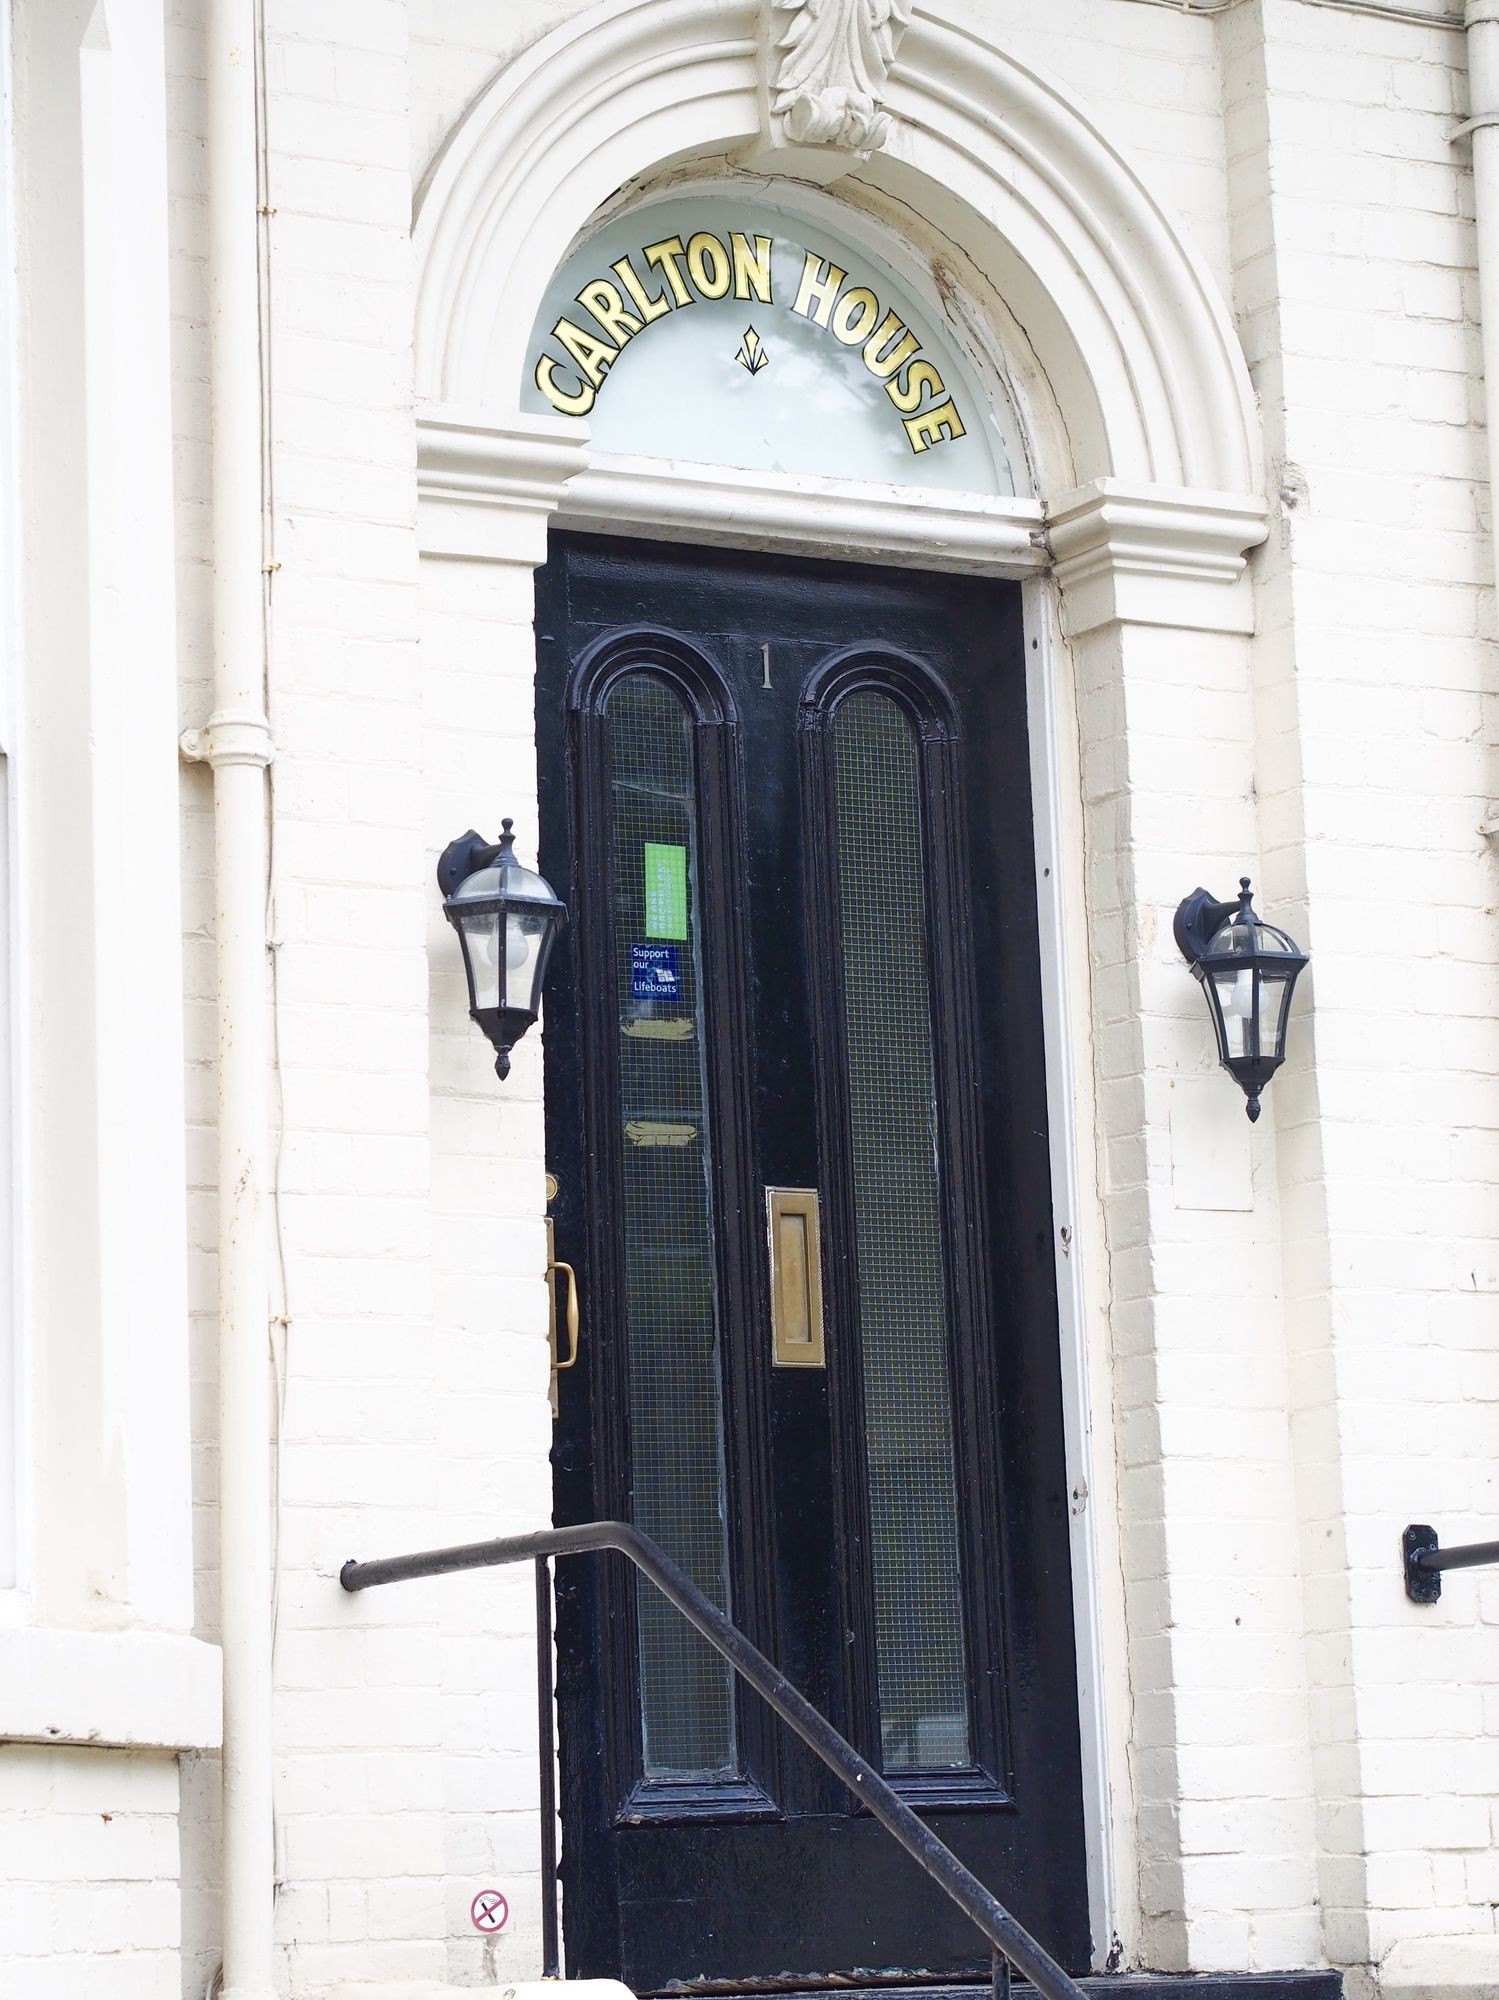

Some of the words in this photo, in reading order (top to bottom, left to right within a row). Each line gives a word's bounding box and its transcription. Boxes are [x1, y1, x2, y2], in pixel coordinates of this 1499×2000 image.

[535, 231, 774, 416] CARLTON
[791, 248, 967, 454] HOUSE
[760, 643, 773, 689] 1
[633, 947, 669, 960] Support
[633, 960, 649, 969] our
[634, 981, 677, 993] Lifeboats
